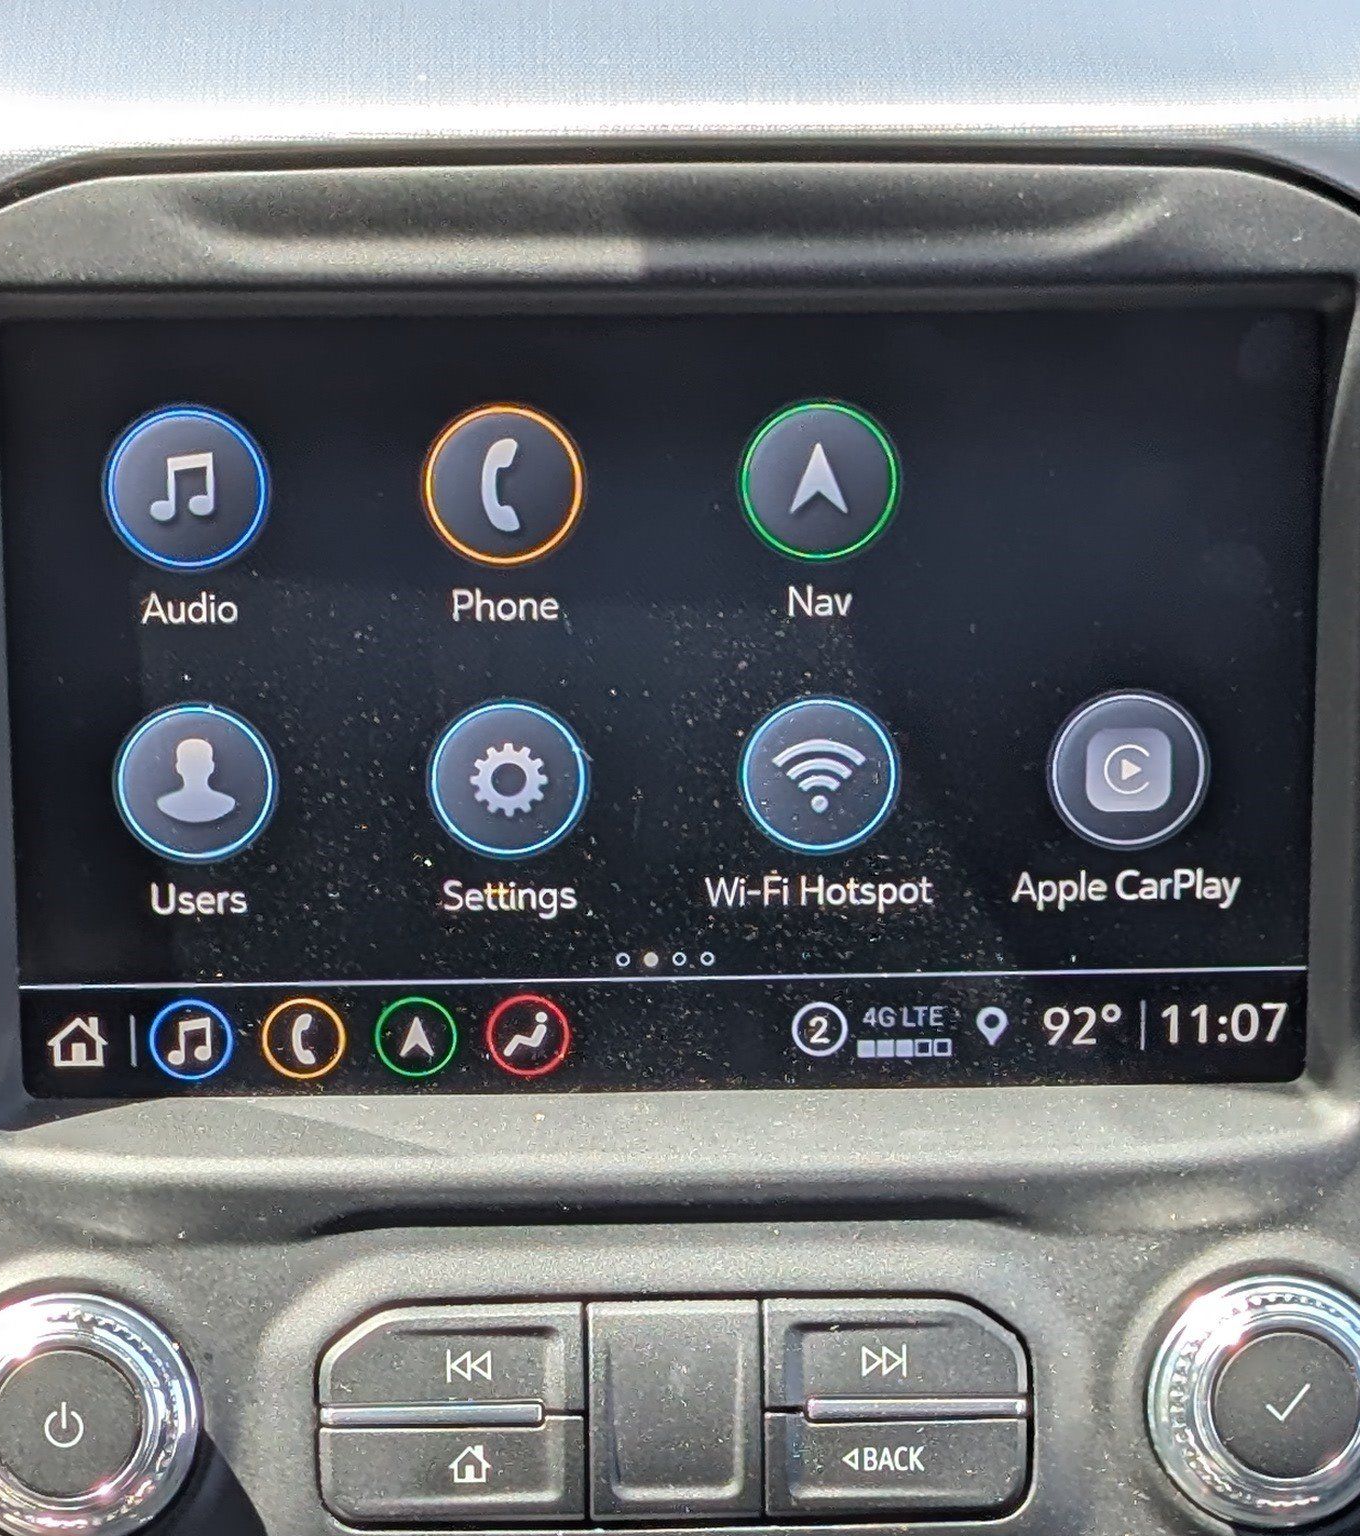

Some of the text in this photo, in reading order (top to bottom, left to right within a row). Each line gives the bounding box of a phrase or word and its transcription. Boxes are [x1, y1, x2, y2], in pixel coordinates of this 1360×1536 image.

[141, 592, 239, 625] Audio
[452, 588, 560, 622] Phone
[788, 585, 853, 617] Nav
[151, 883, 247, 915] Users
[443, 879, 577, 919] Settings
[705, 873, 935, 912] Wi-Fi Hotspot
[1012, 868, 1241, 910] Apple CarPlay
[1042, 1003, 1122, 1047] 92°
[1160, 1002, 1289, 1044] 11:07
[864, 1446, 925, 1473] BACK
